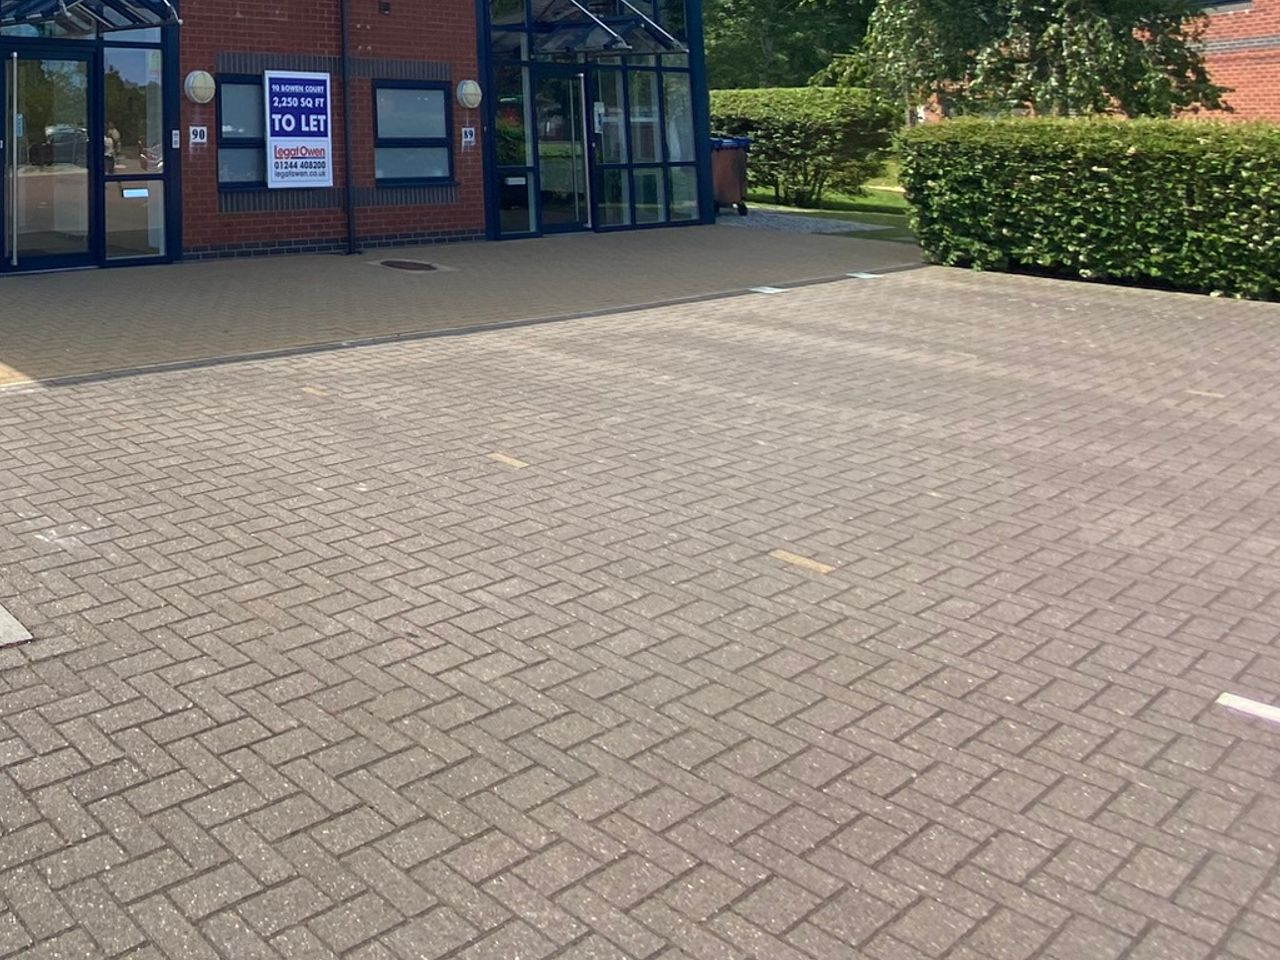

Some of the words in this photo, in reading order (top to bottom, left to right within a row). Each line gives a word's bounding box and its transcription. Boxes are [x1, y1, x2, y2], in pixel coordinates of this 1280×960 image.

[272, 96, 299, 108] 2,250
[300, 97, 313, 108] SQ
[314, 98, 325, 108] FT
[271, 113, 296, 131] TO
[301, 114, 327, 131] LET
[191, 128, 206, 140] 90
[463, 129, 474, 140] 89
[273, 160, 298, 170] 01244
